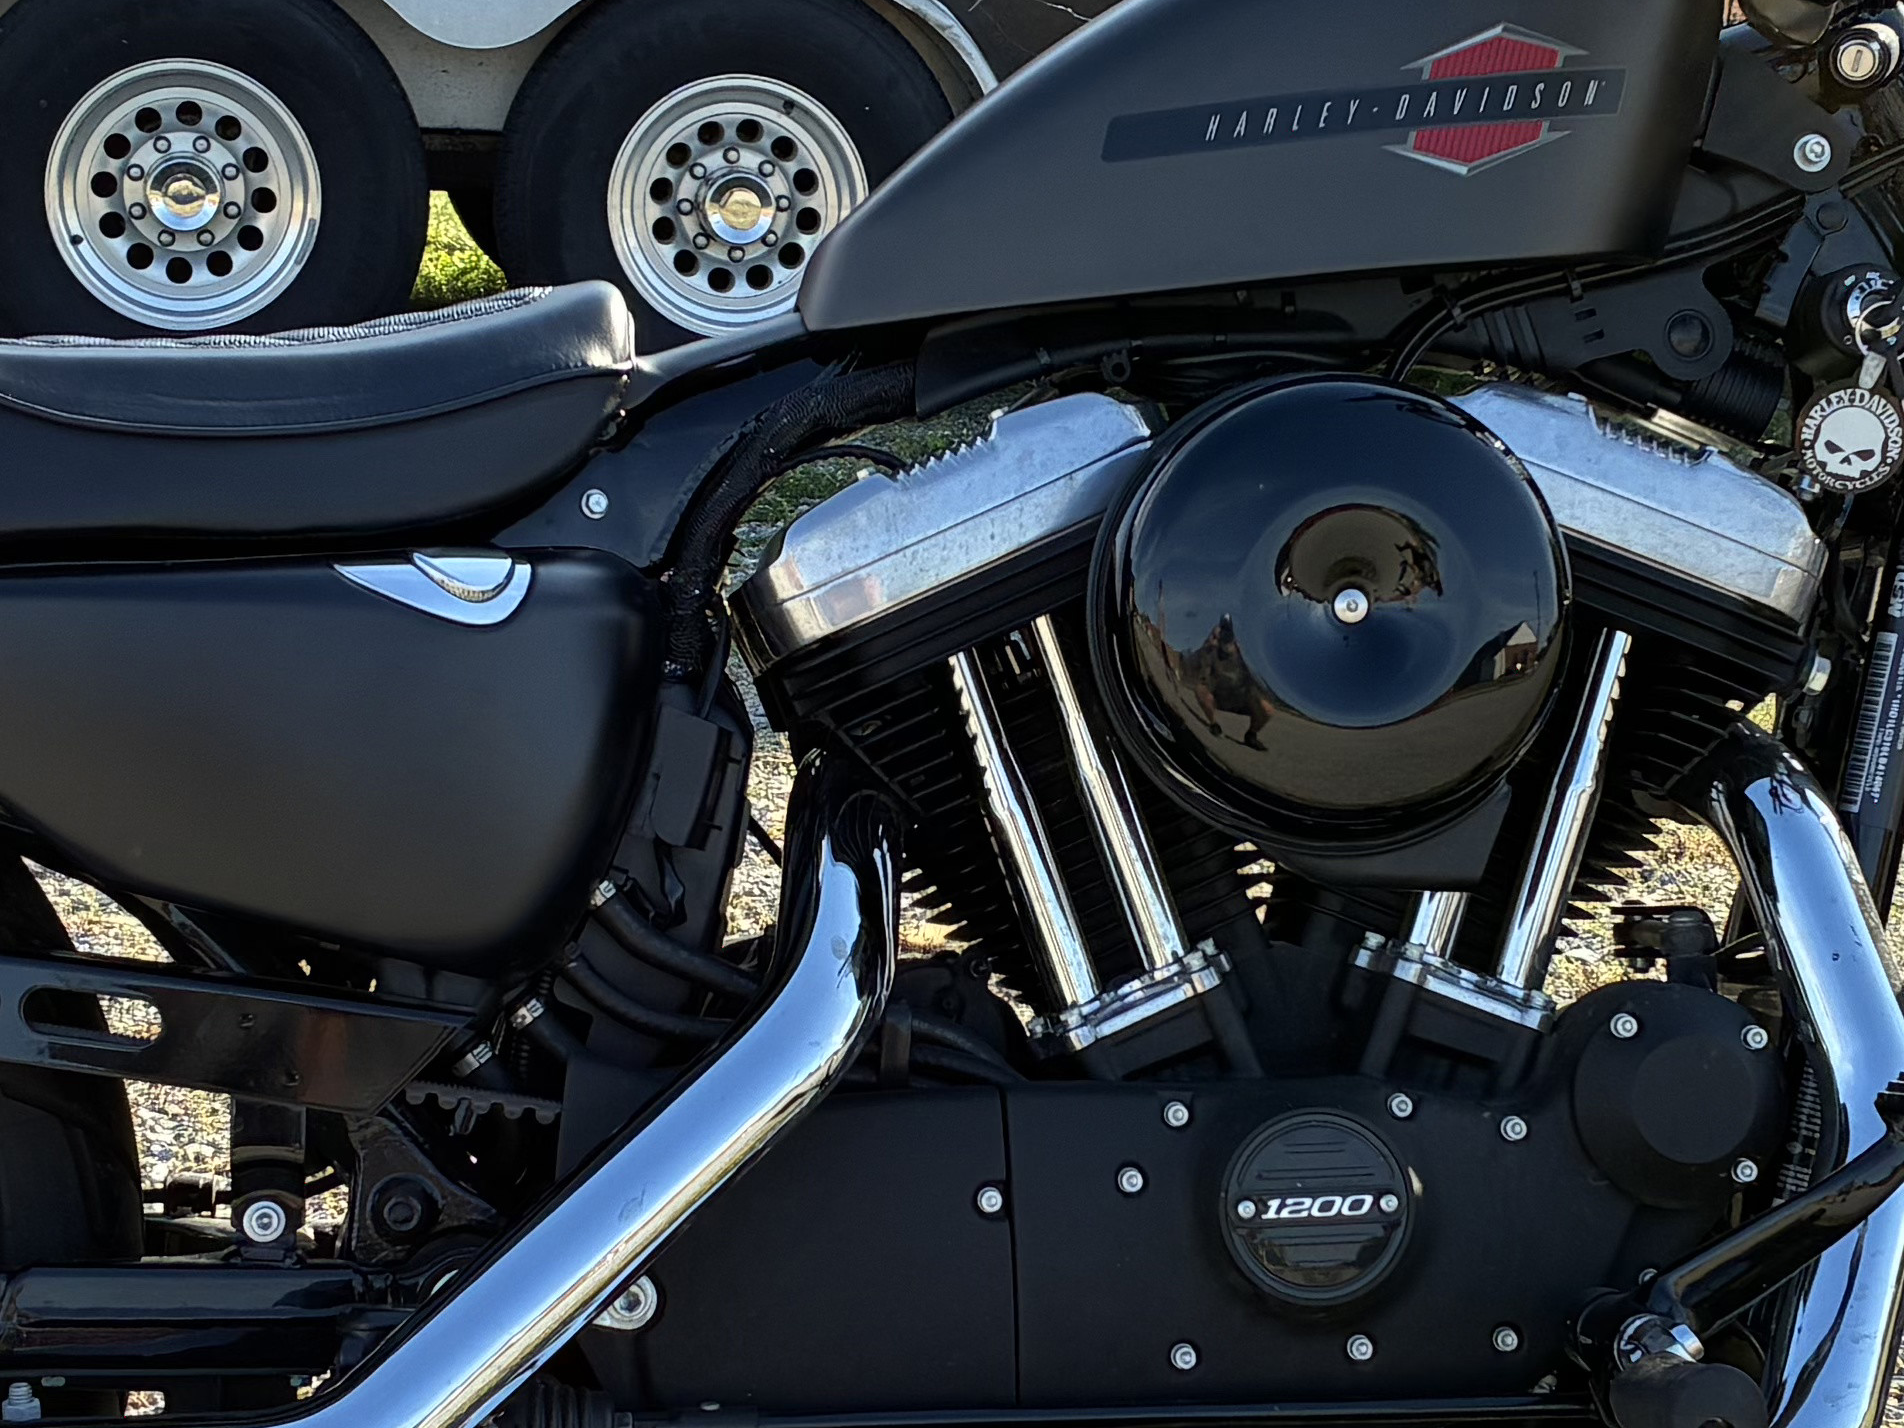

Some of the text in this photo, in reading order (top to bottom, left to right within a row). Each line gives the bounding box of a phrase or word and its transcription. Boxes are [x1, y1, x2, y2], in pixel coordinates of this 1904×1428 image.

[1800, 388, 1903, 461] HARLEY-DAVIDSON
[1801, 449, 1891, 490] MOTORCYCLES
[1260, 1194, 1374, 1220] 1200
